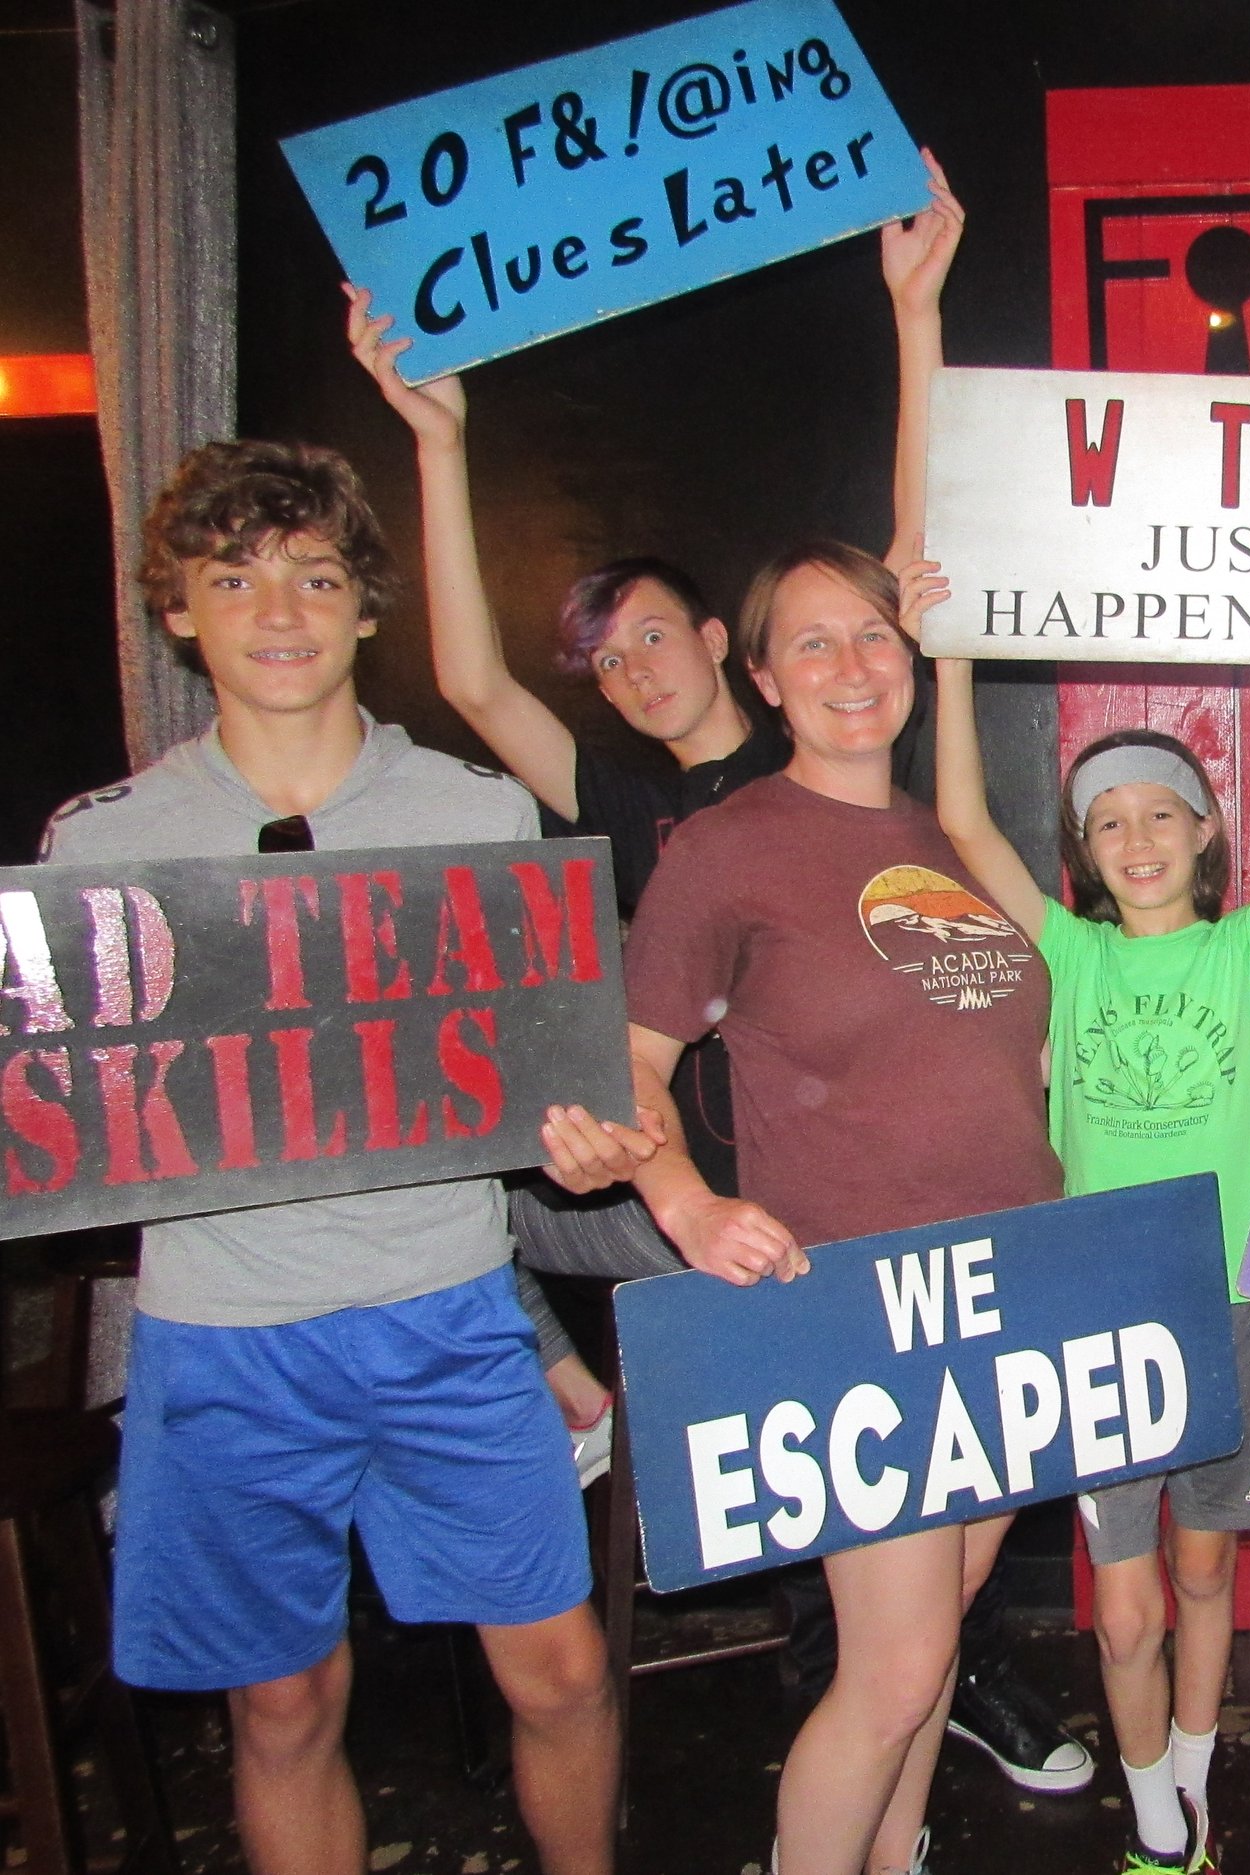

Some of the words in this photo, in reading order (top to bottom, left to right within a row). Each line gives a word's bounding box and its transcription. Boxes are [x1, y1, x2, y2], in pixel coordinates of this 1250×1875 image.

[346, 131, 469, 229] 20
[413, 217, 646, 336] Clues
[663, 131, 874, 248] Later
[0, 886, 175, 1035] AD
[240, 860, 604, 1011] TEAM
[922, 974, 984, 991] NATIONAL
[990, 970, 1022, 984] PARK
[932, 951, 1008, 974] ACADIA
[1134, 992, 1237, 1086] FLYTRAP
[2, 1008, 506, 1197] SKILLS
[1086, 1113, 1121, 1129] Franklin
[1122, 1119, 1142, 1130] Park
[1143, 1114, 1209, 1131] Conservatory
[1104, 1128, 1117, 1137] and
[1118, 1130, 1153, 1140] Botanical
[1153, 1129, 1187, 1139] Gardens
[875, 1238, 1001, 1353] WE
[687, 1322, 1188, 1570] ESCAPED
